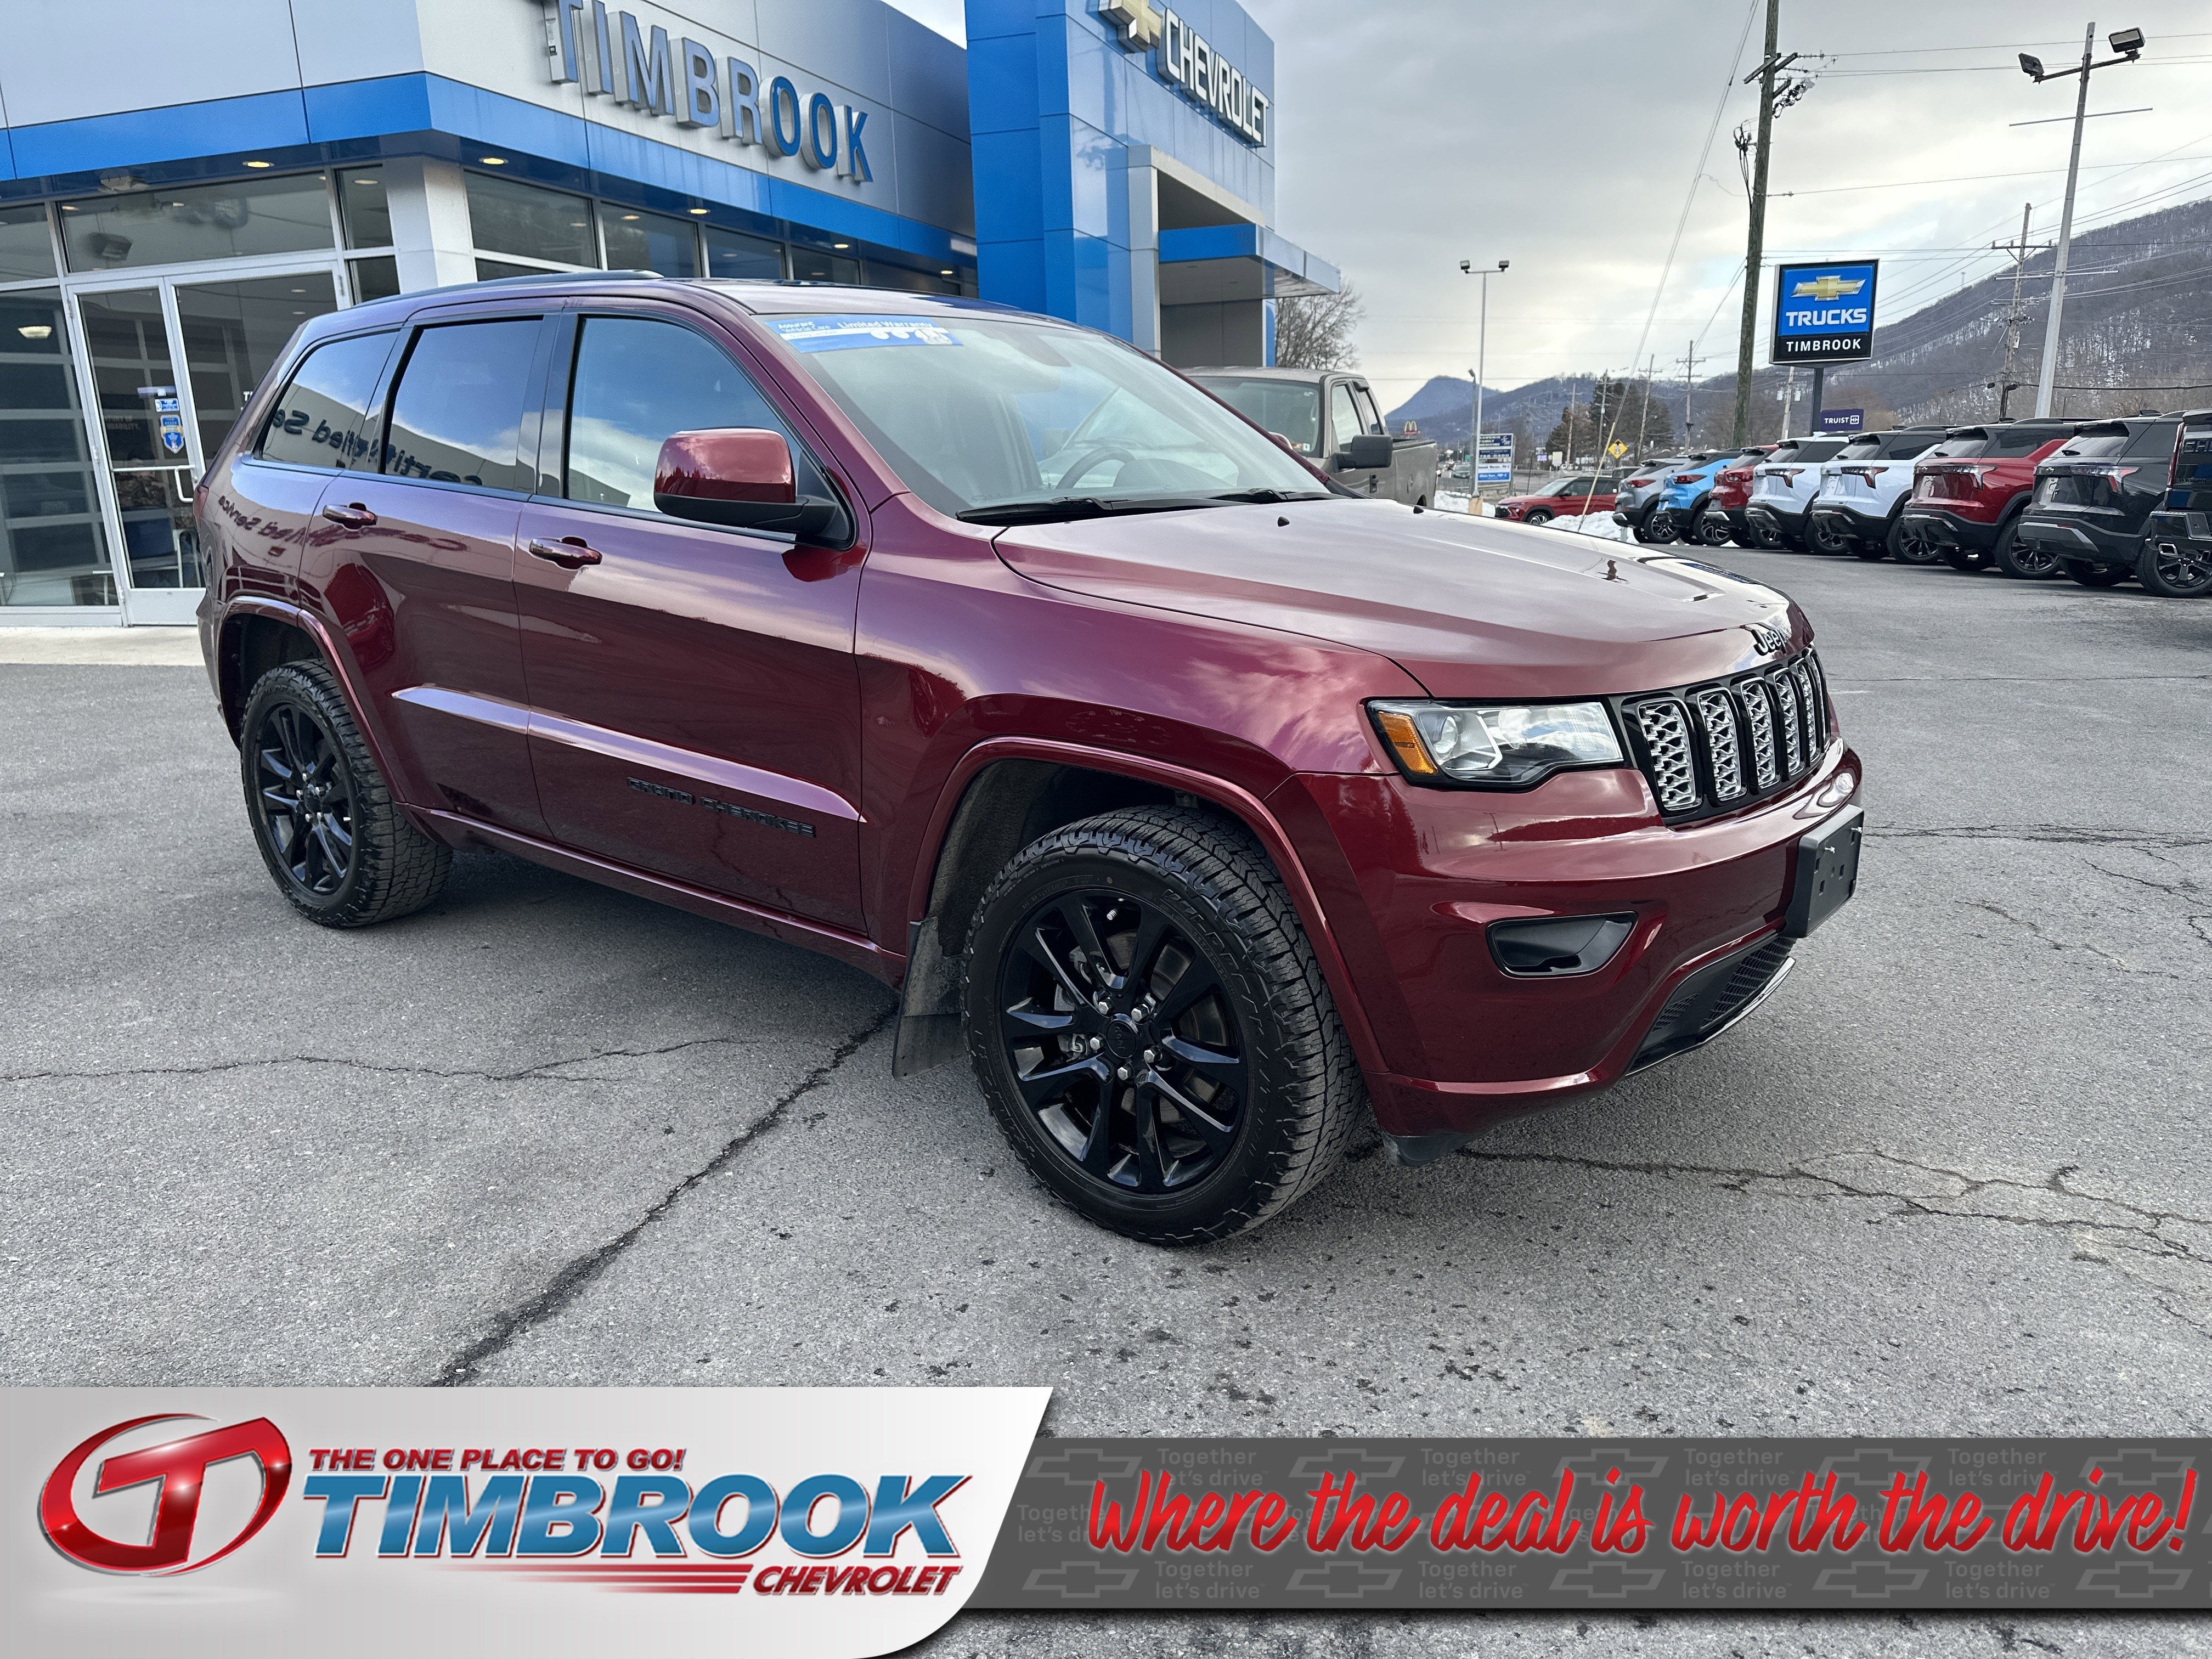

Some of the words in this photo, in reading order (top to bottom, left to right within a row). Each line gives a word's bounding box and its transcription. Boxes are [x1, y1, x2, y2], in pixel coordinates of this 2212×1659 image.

[548, 0, 873, 183] TIMBROOK
[1162, 8, 1269, 148] CHEVROLET
[1786, 308, 1867, 327] TRUCKS
[1786, 338, 1863, 352] TIMBROOK
[1754, 629, 1787, 654] Jeep
[627, 777, 696, 805] GRAND
[700, 797, 817, 838] CHEROKEE
